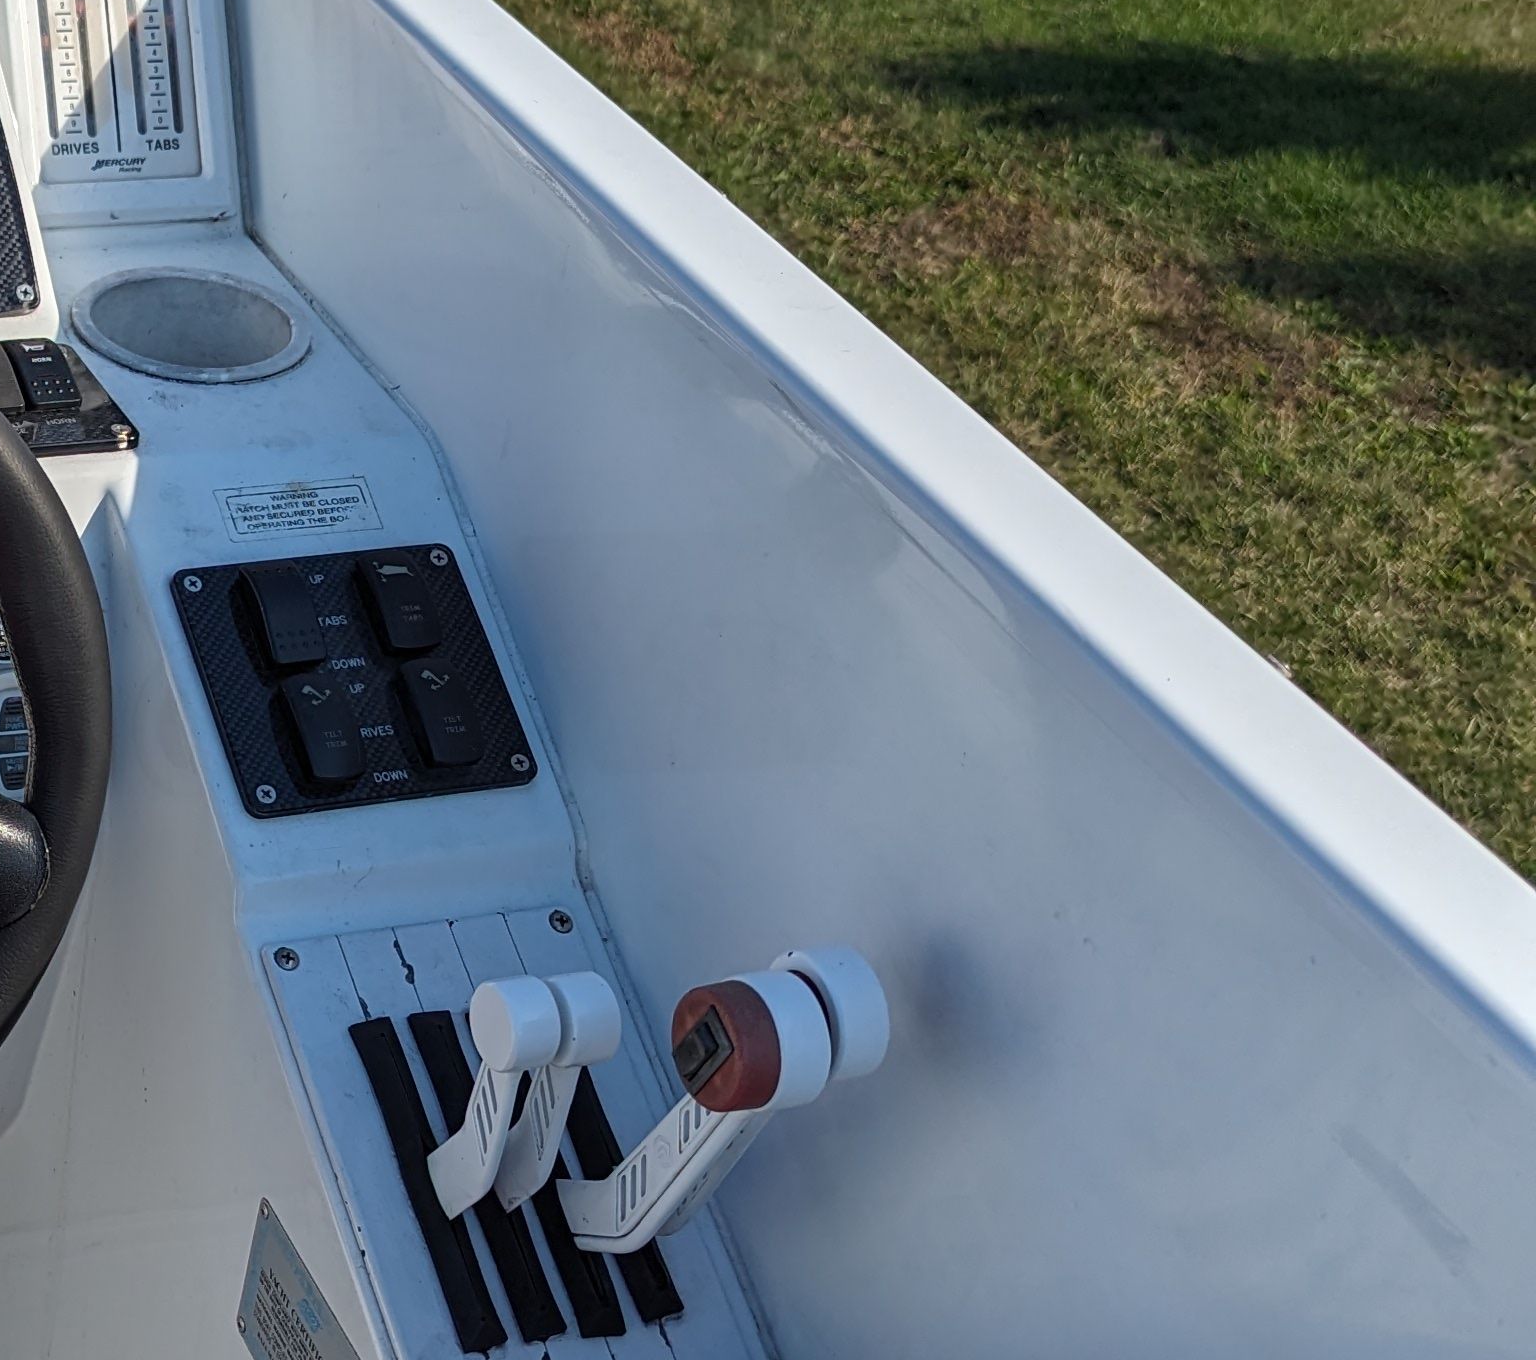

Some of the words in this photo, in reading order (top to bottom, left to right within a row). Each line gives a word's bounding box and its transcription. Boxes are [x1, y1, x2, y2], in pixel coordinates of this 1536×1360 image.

[60, 1, 65, 10] 2
[61, 18, 67, 27] 3
[63, 35, 69, 43] 4
[152, 49, 157, 57] 4
[153, 66, 159, 74] 3
[155, 82, 160, 91] 2
[157, 99, 161, 107] 1
[157, 116, 163, 124] 0
[51, 141, 100, 156] DRIVES
[145, 138, 180, 152] TABS
[93, 157, 147, 168] MERCURY
[270, 492, 319, 502] WARNING
[302, 500, 316, 508] BE
[317, 496, 360, 507] CLOSED
[267, 509, 316, 521] SECURED
[247, 520, 306, 531] OPERATING
[307, 516, 328, 525] THE
[309, 574, 325, 585] UP
[317, 615, 348, 627] TABS
[331, 657, 365, 670] DOWN
[348, 684, 365, 694] UP
[373, 769, 409, 783] DOWN
[269, 1267, 291, 1309] YACHT
